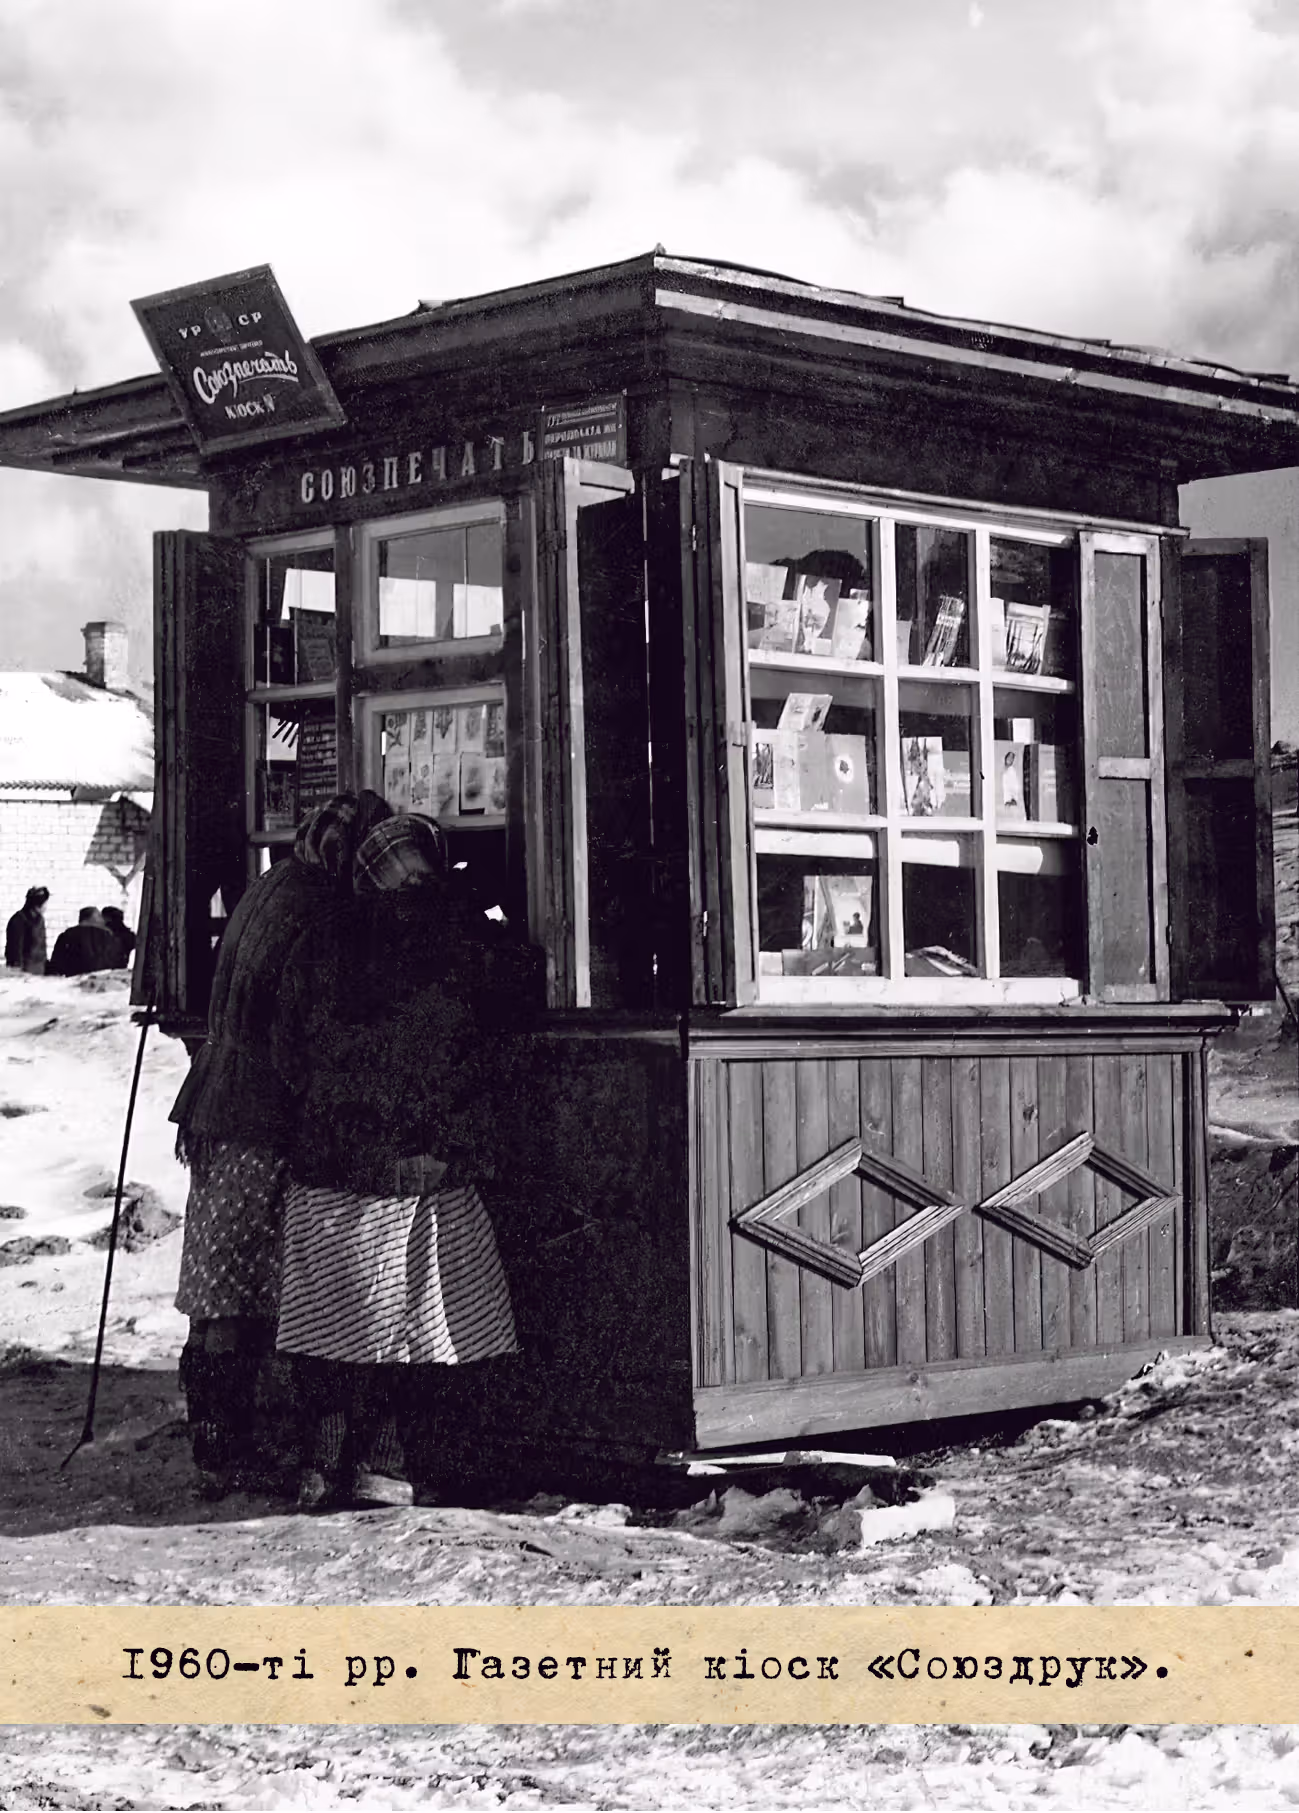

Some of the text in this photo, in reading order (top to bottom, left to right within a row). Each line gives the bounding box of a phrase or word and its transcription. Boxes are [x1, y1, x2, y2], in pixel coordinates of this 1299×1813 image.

[238, 312, 262, 325] СР
[193, 350, 298, 404] Союзпечать
[301, 431, 535, 503] СОЮЗПЕЧАТЬ
